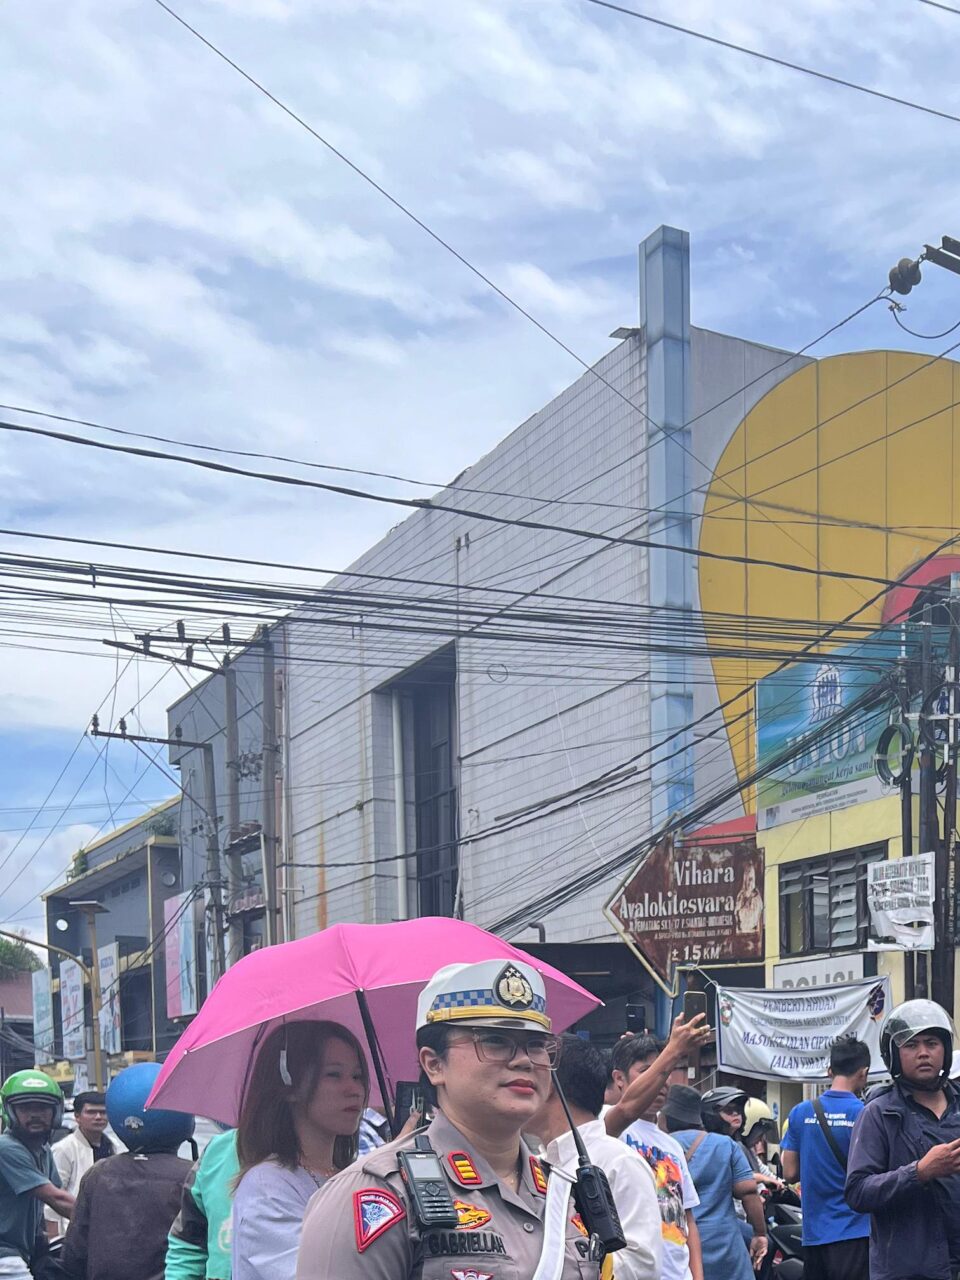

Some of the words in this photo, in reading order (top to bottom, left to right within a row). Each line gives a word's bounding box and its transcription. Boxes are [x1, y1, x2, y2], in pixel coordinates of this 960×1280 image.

[836, 765, 854, 780] kerja
[855, 756, 874, 772] sama
[674, 860, 735, 886] Vihara
[619, 892, 735, 919] Avalokitesvara
[703, 944, 720, 960] KM
[786, 1035, 810, 1051] JALAN
[770, 1055, 799, 1070] JALAN
[428, 1231, 507, 1255] GABRIELLAH
